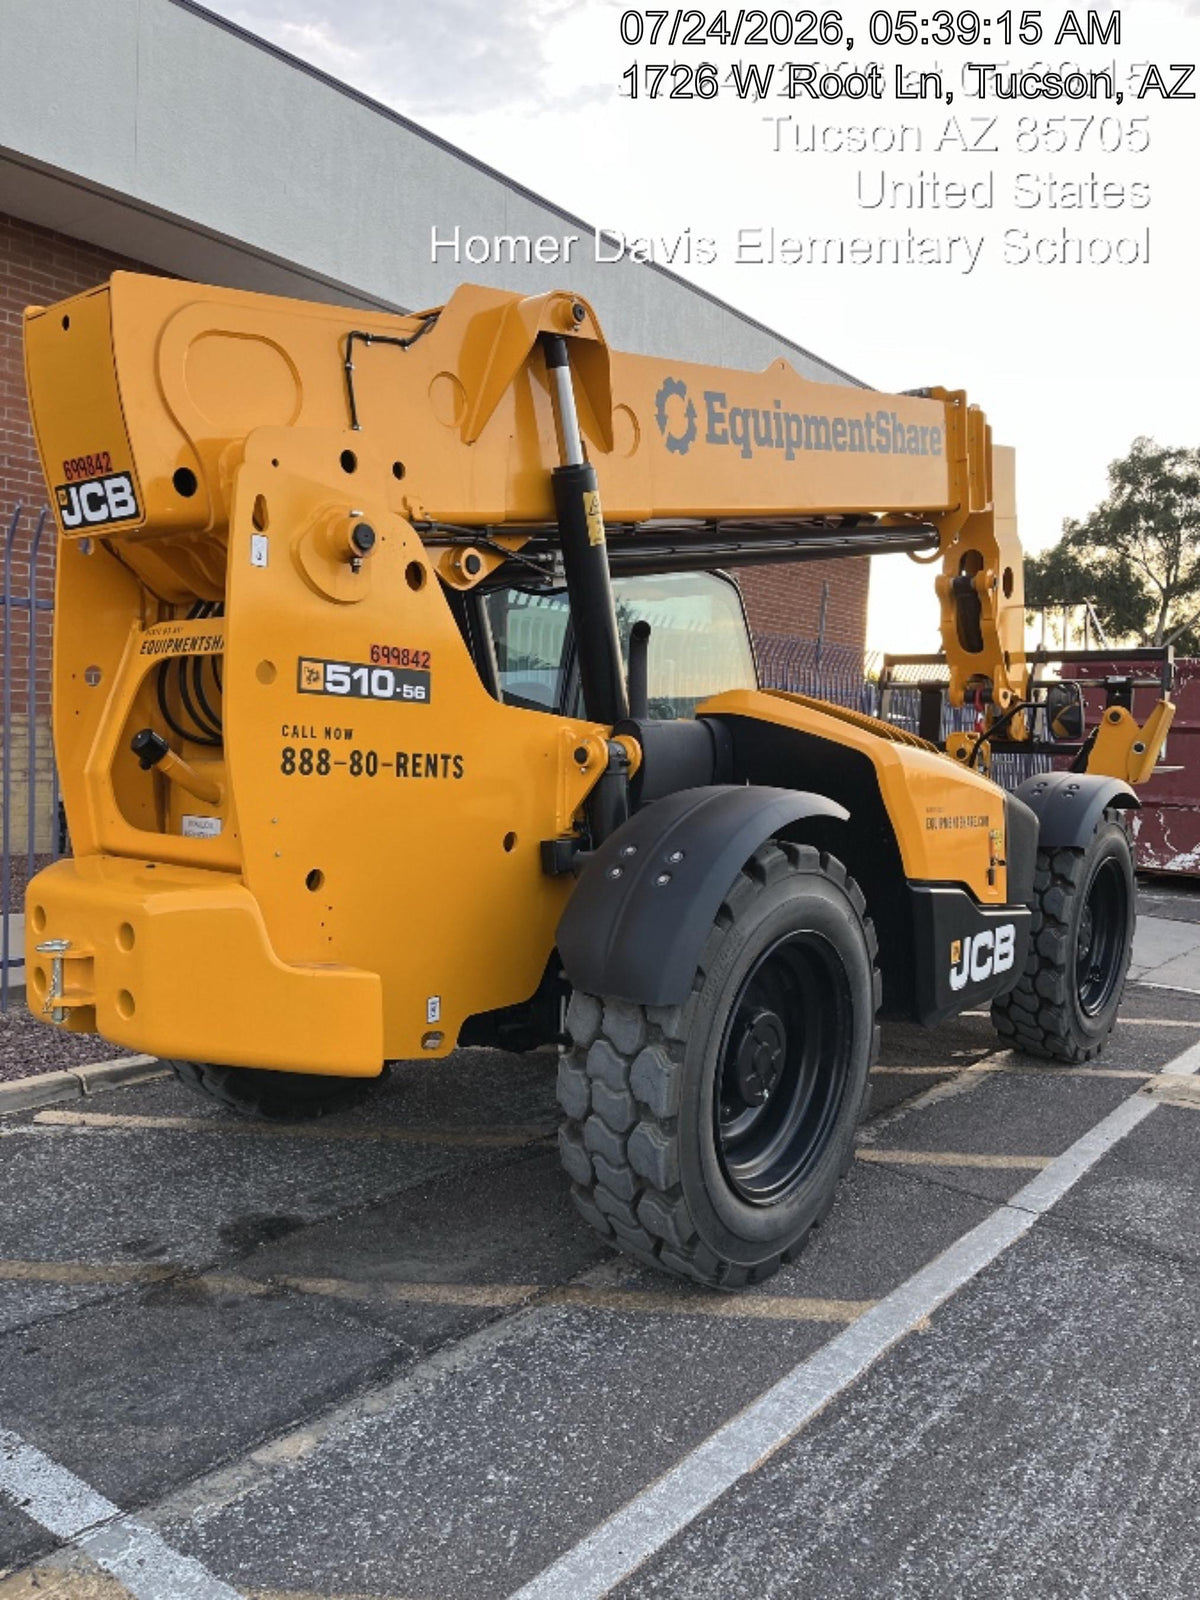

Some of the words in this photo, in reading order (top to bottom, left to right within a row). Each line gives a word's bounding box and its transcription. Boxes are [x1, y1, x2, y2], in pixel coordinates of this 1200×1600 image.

[704, 391, 942, 461] EquipmentShare
[63, 451, 113, 481] 699842
[61, 476, 137, 526] JCB
[370, 644, 430, 669] 699842
[281, 724, 317, 739] CALL
[325, 726, 354, 740] NOW
[280, 746, 464, 779] 888-80-RENTS
[950, 924, 1016, 991] JCB
